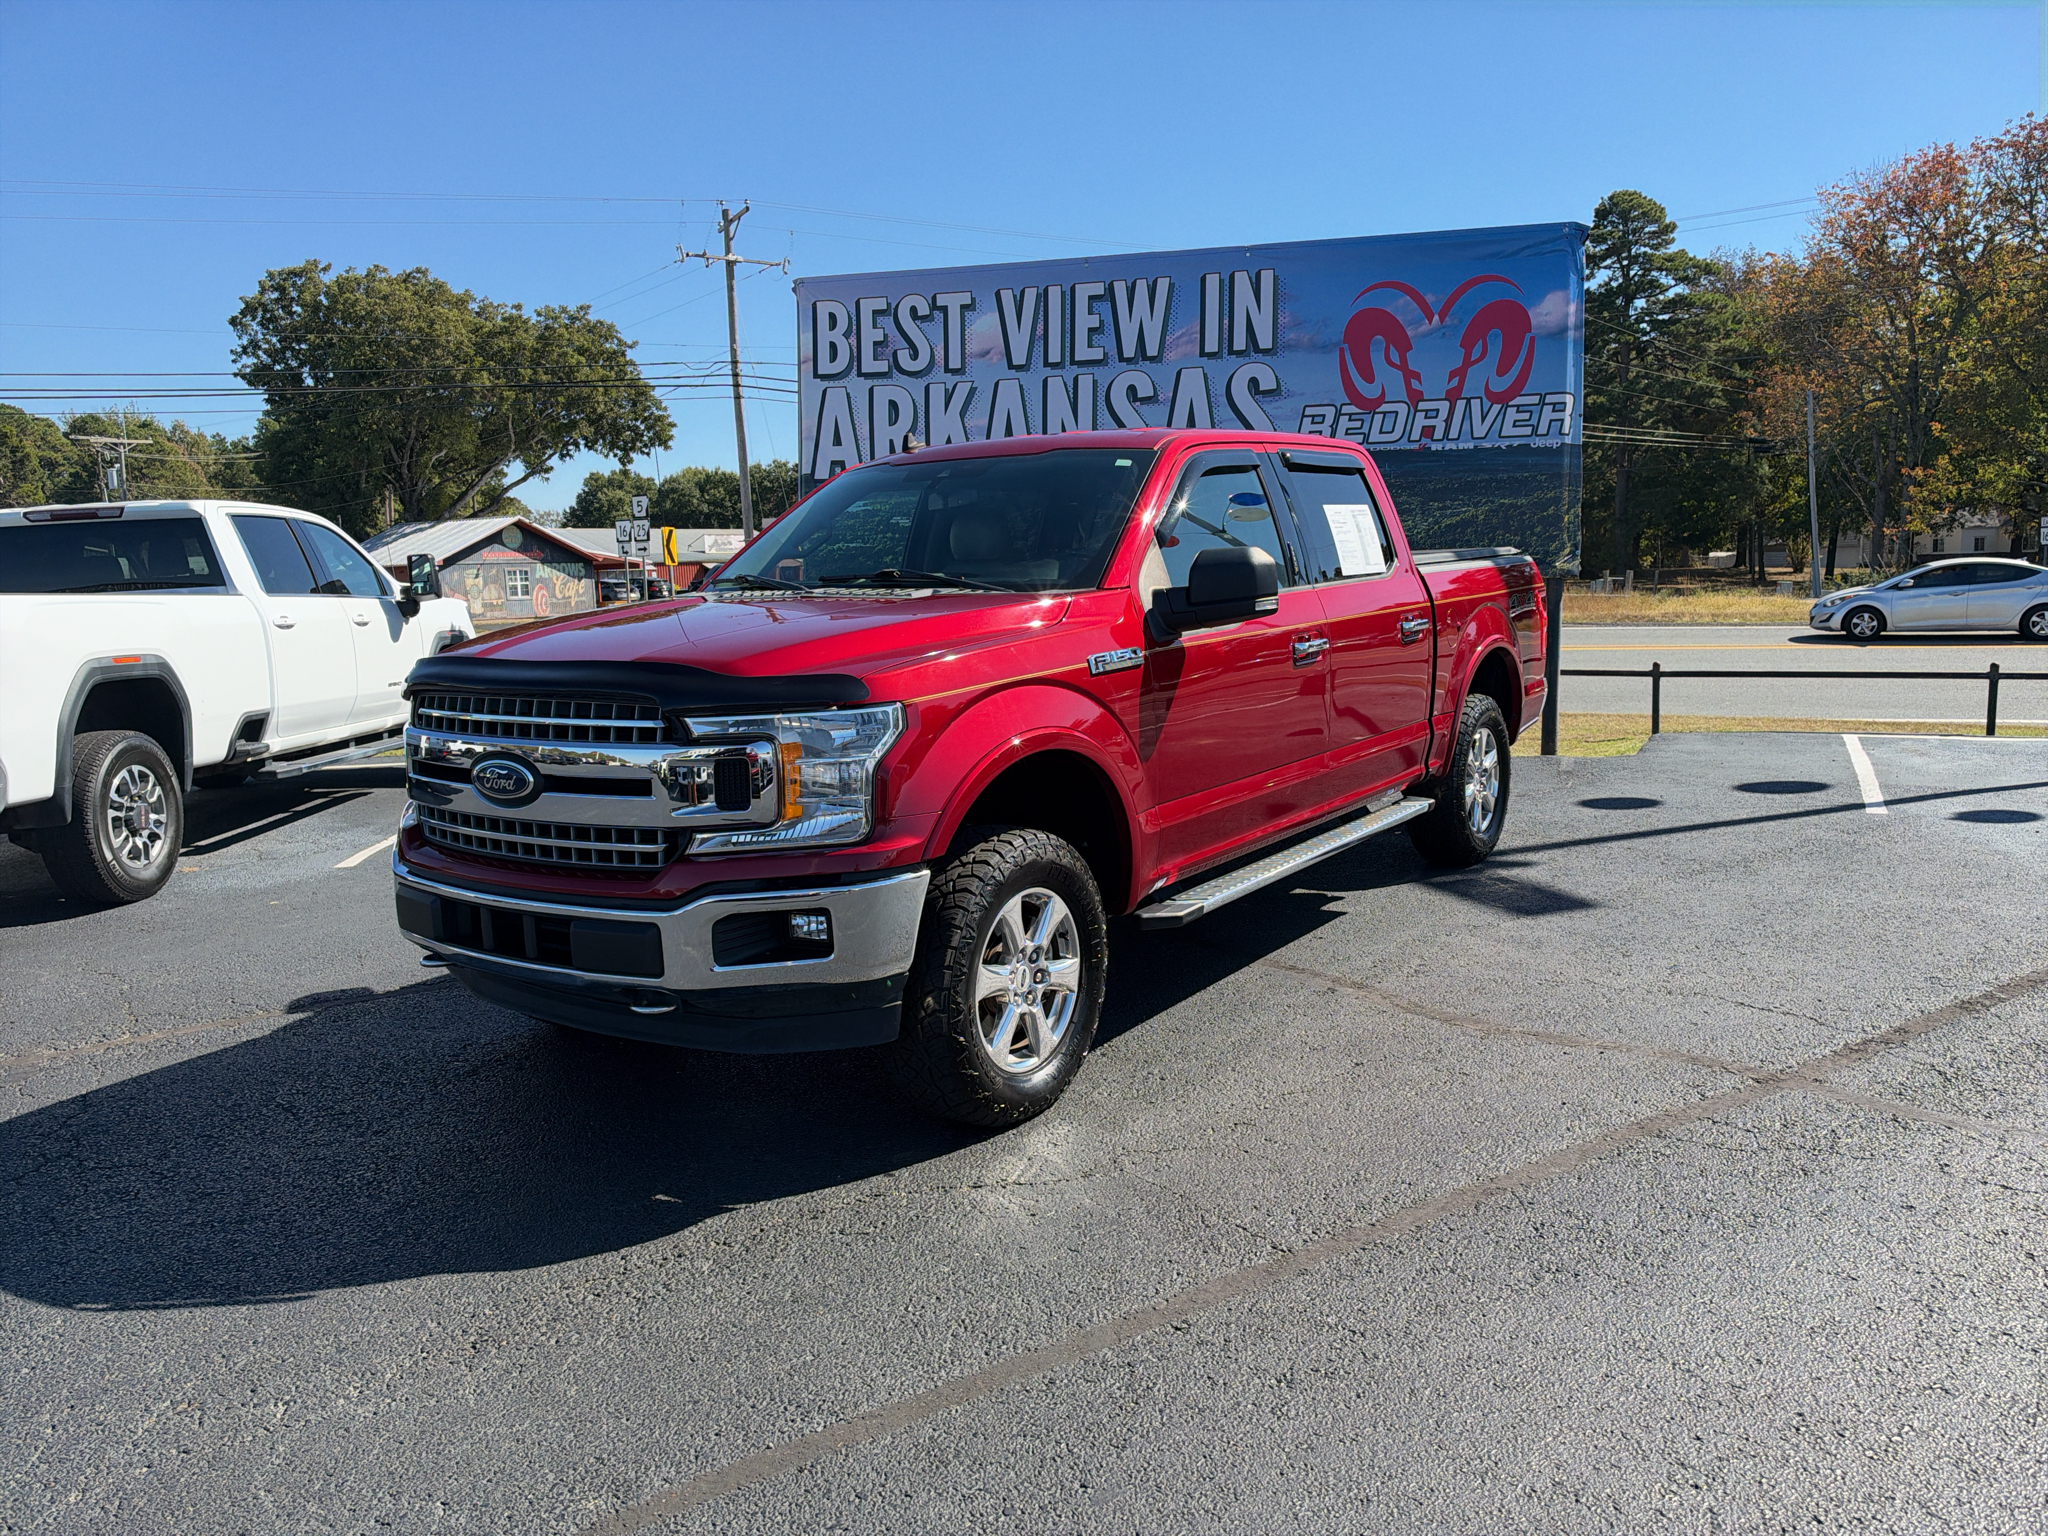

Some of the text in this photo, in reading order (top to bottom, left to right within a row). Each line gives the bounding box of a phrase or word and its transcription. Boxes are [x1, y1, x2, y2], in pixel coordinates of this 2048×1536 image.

[812, 268, 1278, 381] BEST VIEW IN
[811, 361, 1280, 481] ARKANSAS
[1430, 442, 1474, 451] RAM
[1530, 437, 1562, 449] Jeep
[636, 500, 644, 514] 5
[618, 525, 628, 538] 16
[636, 524, 646, 537] 25
[535, 562, 586, 579] ARROWS
[479, 767, 516, 791] Ford
